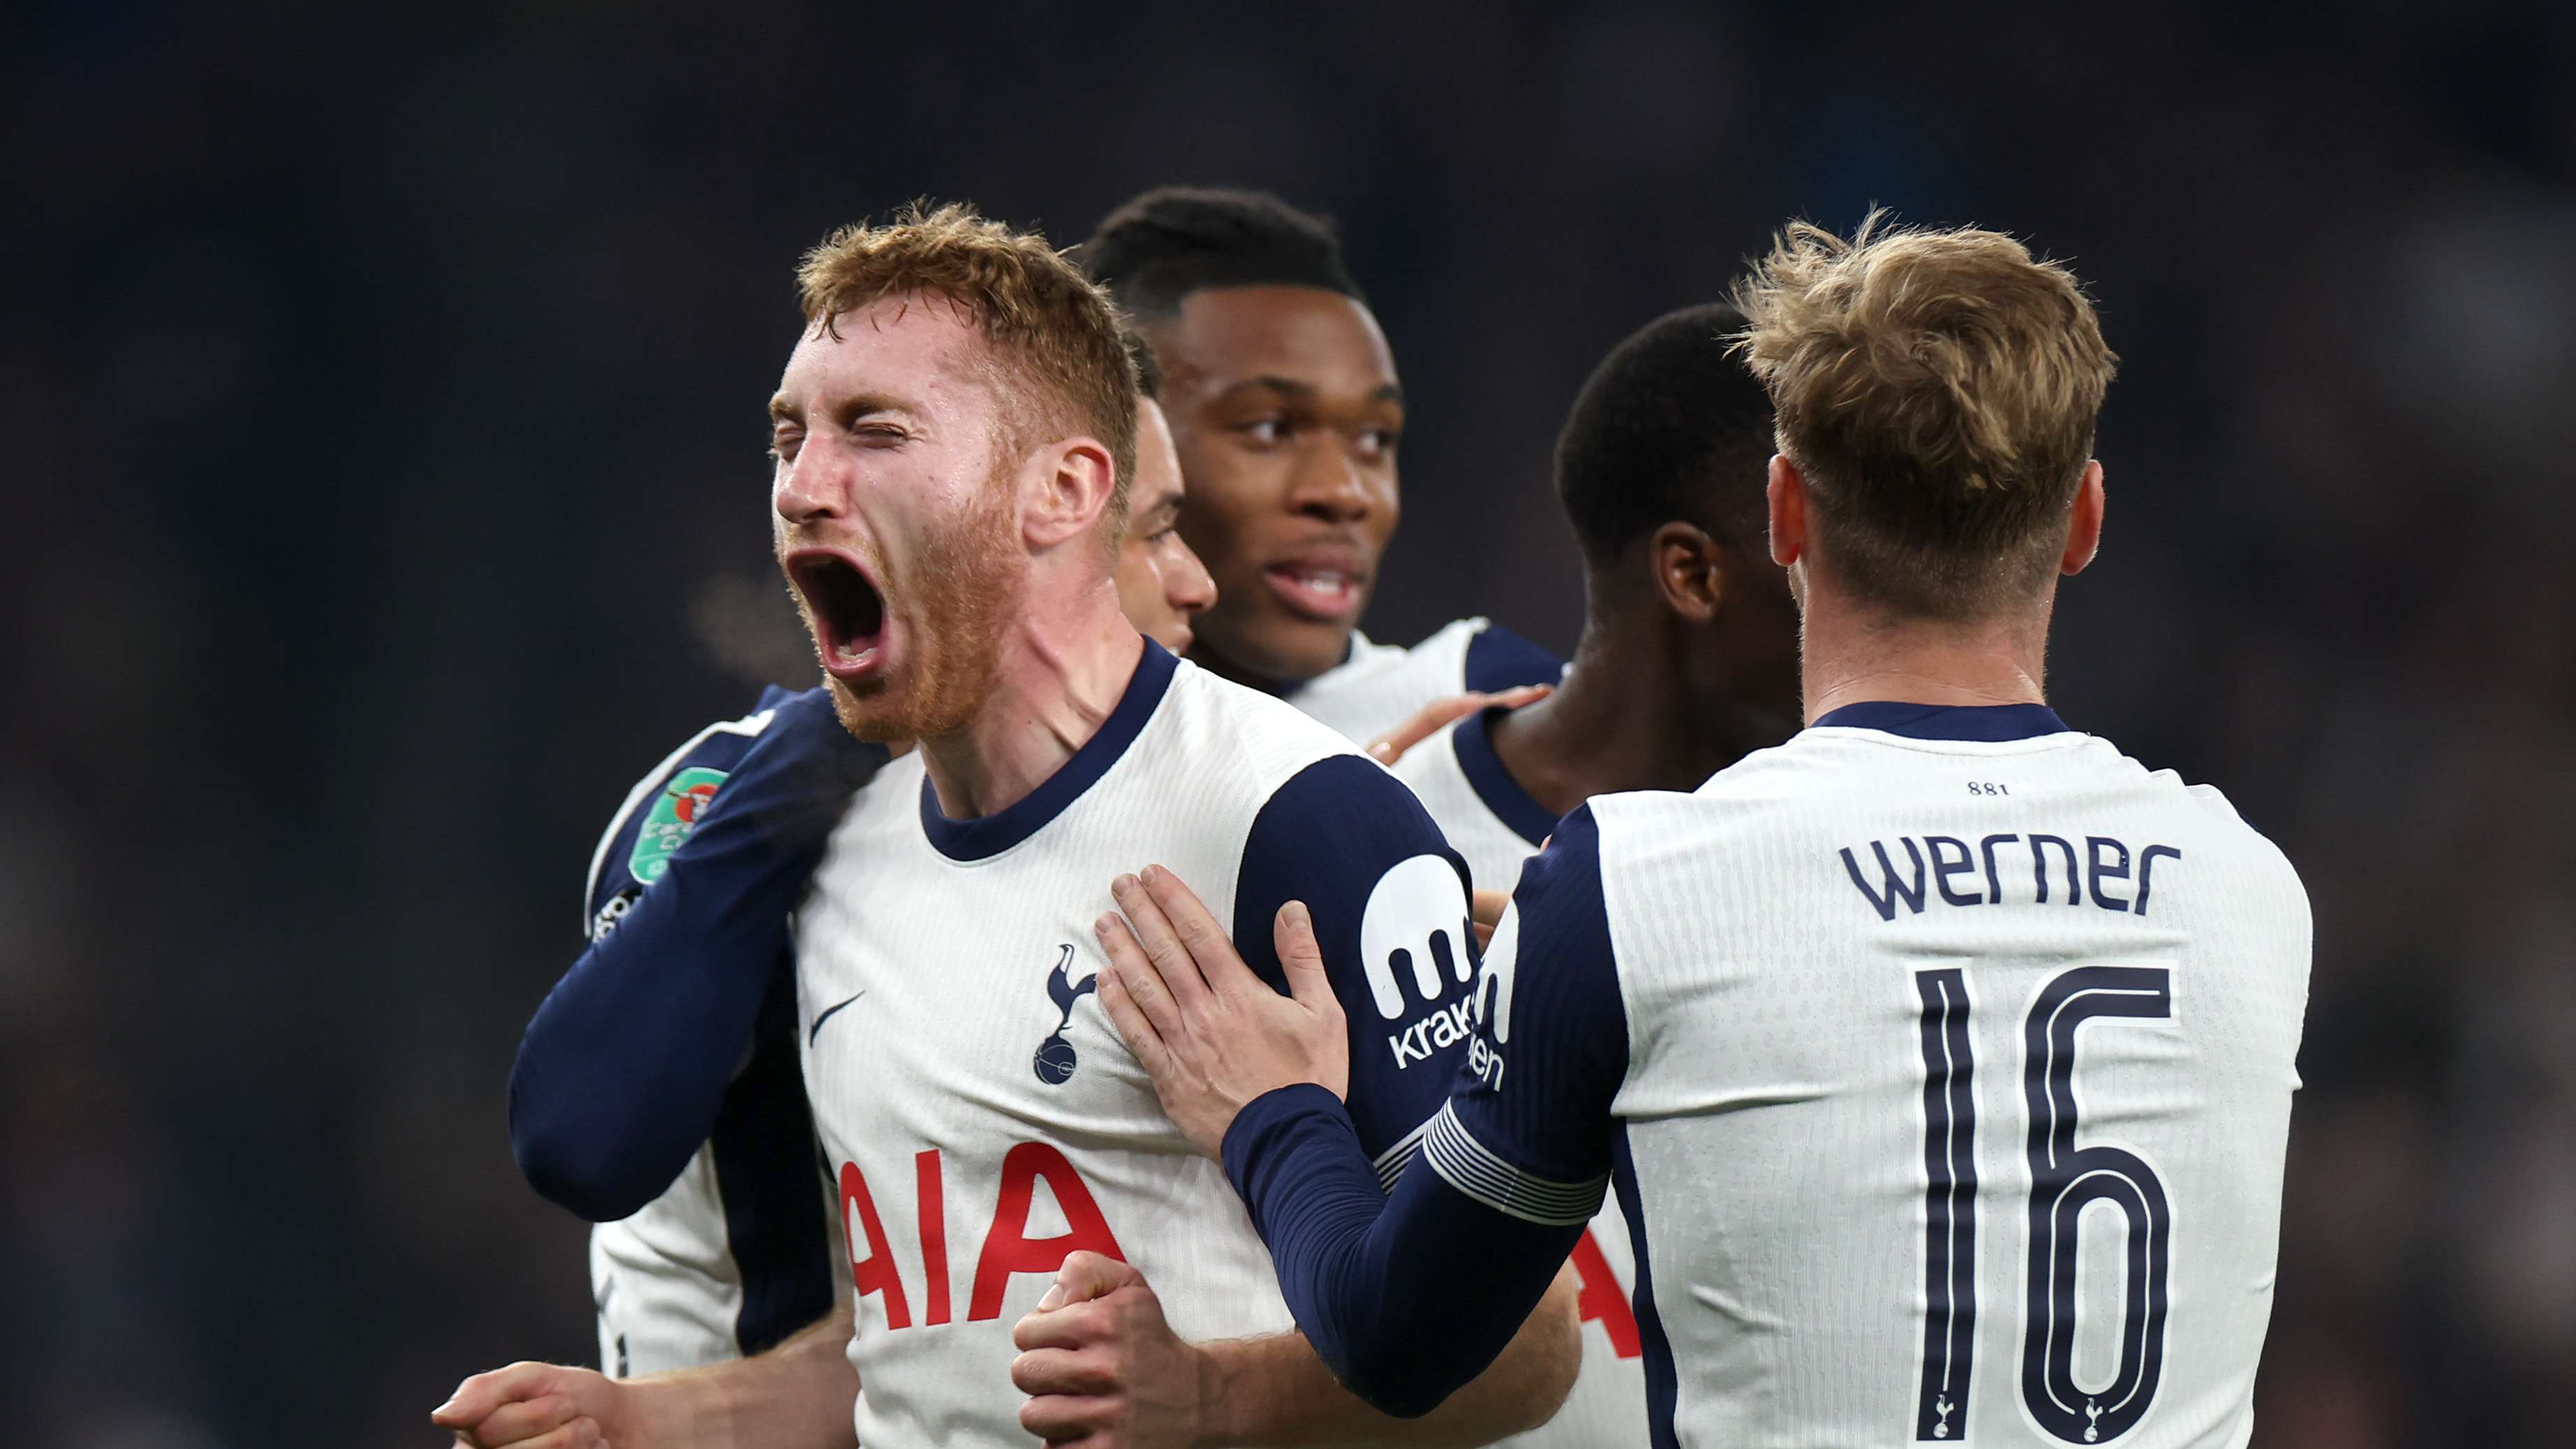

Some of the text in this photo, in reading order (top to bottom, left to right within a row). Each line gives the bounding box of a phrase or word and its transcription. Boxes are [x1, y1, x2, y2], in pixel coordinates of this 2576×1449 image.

[1968, 781, 2009, 796] 881
[1388, 993, 1472, 1070] krak
[840, 1141, 1127, 1330] AIA
[1915, 965, 2172, 1446] 16
